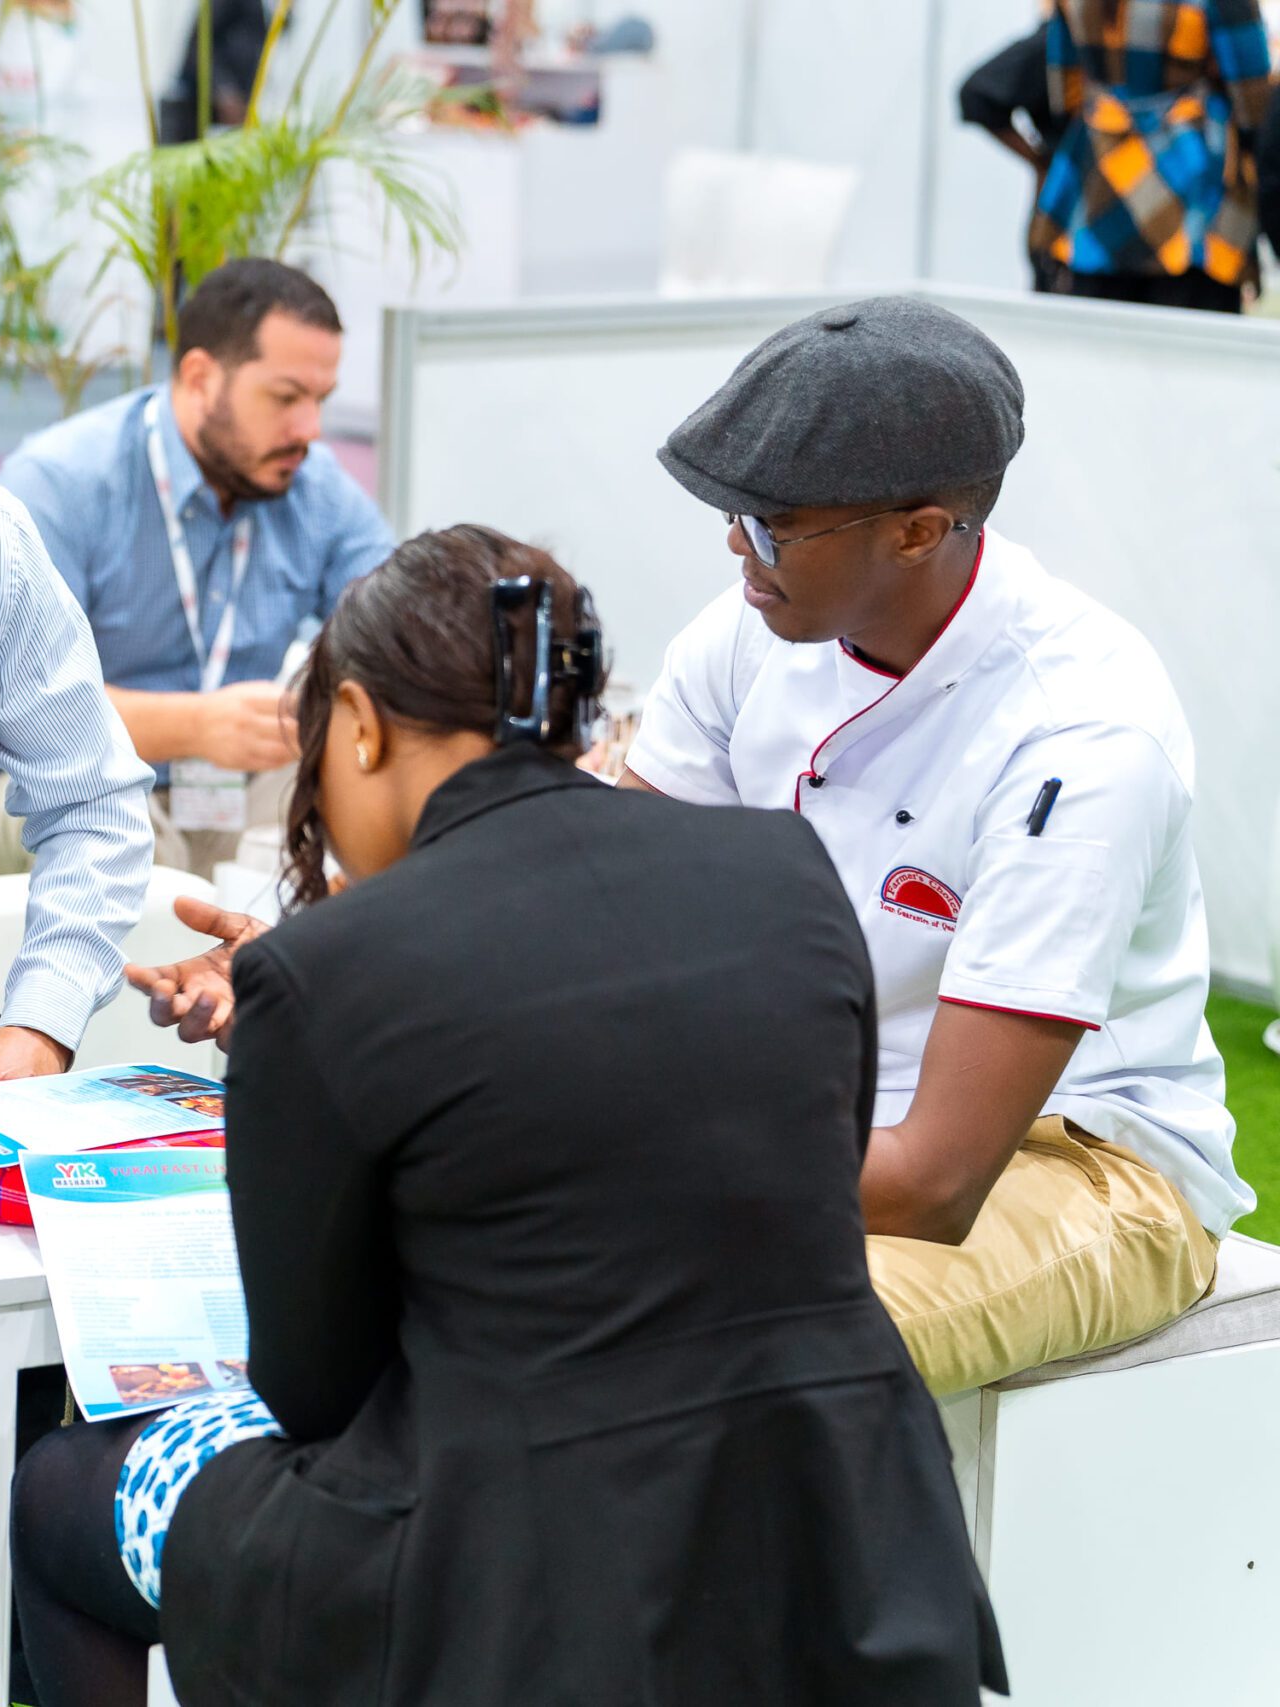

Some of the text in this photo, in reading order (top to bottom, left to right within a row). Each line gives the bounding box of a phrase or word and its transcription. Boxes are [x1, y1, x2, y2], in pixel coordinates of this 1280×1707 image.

[887, 872, 959, 915] Farmer's Choice
[56, 1164, 96, 1178] YK
[109, 1165, 158, 1177] YUKAI
[161, 1163, 199, 1175] EAST
